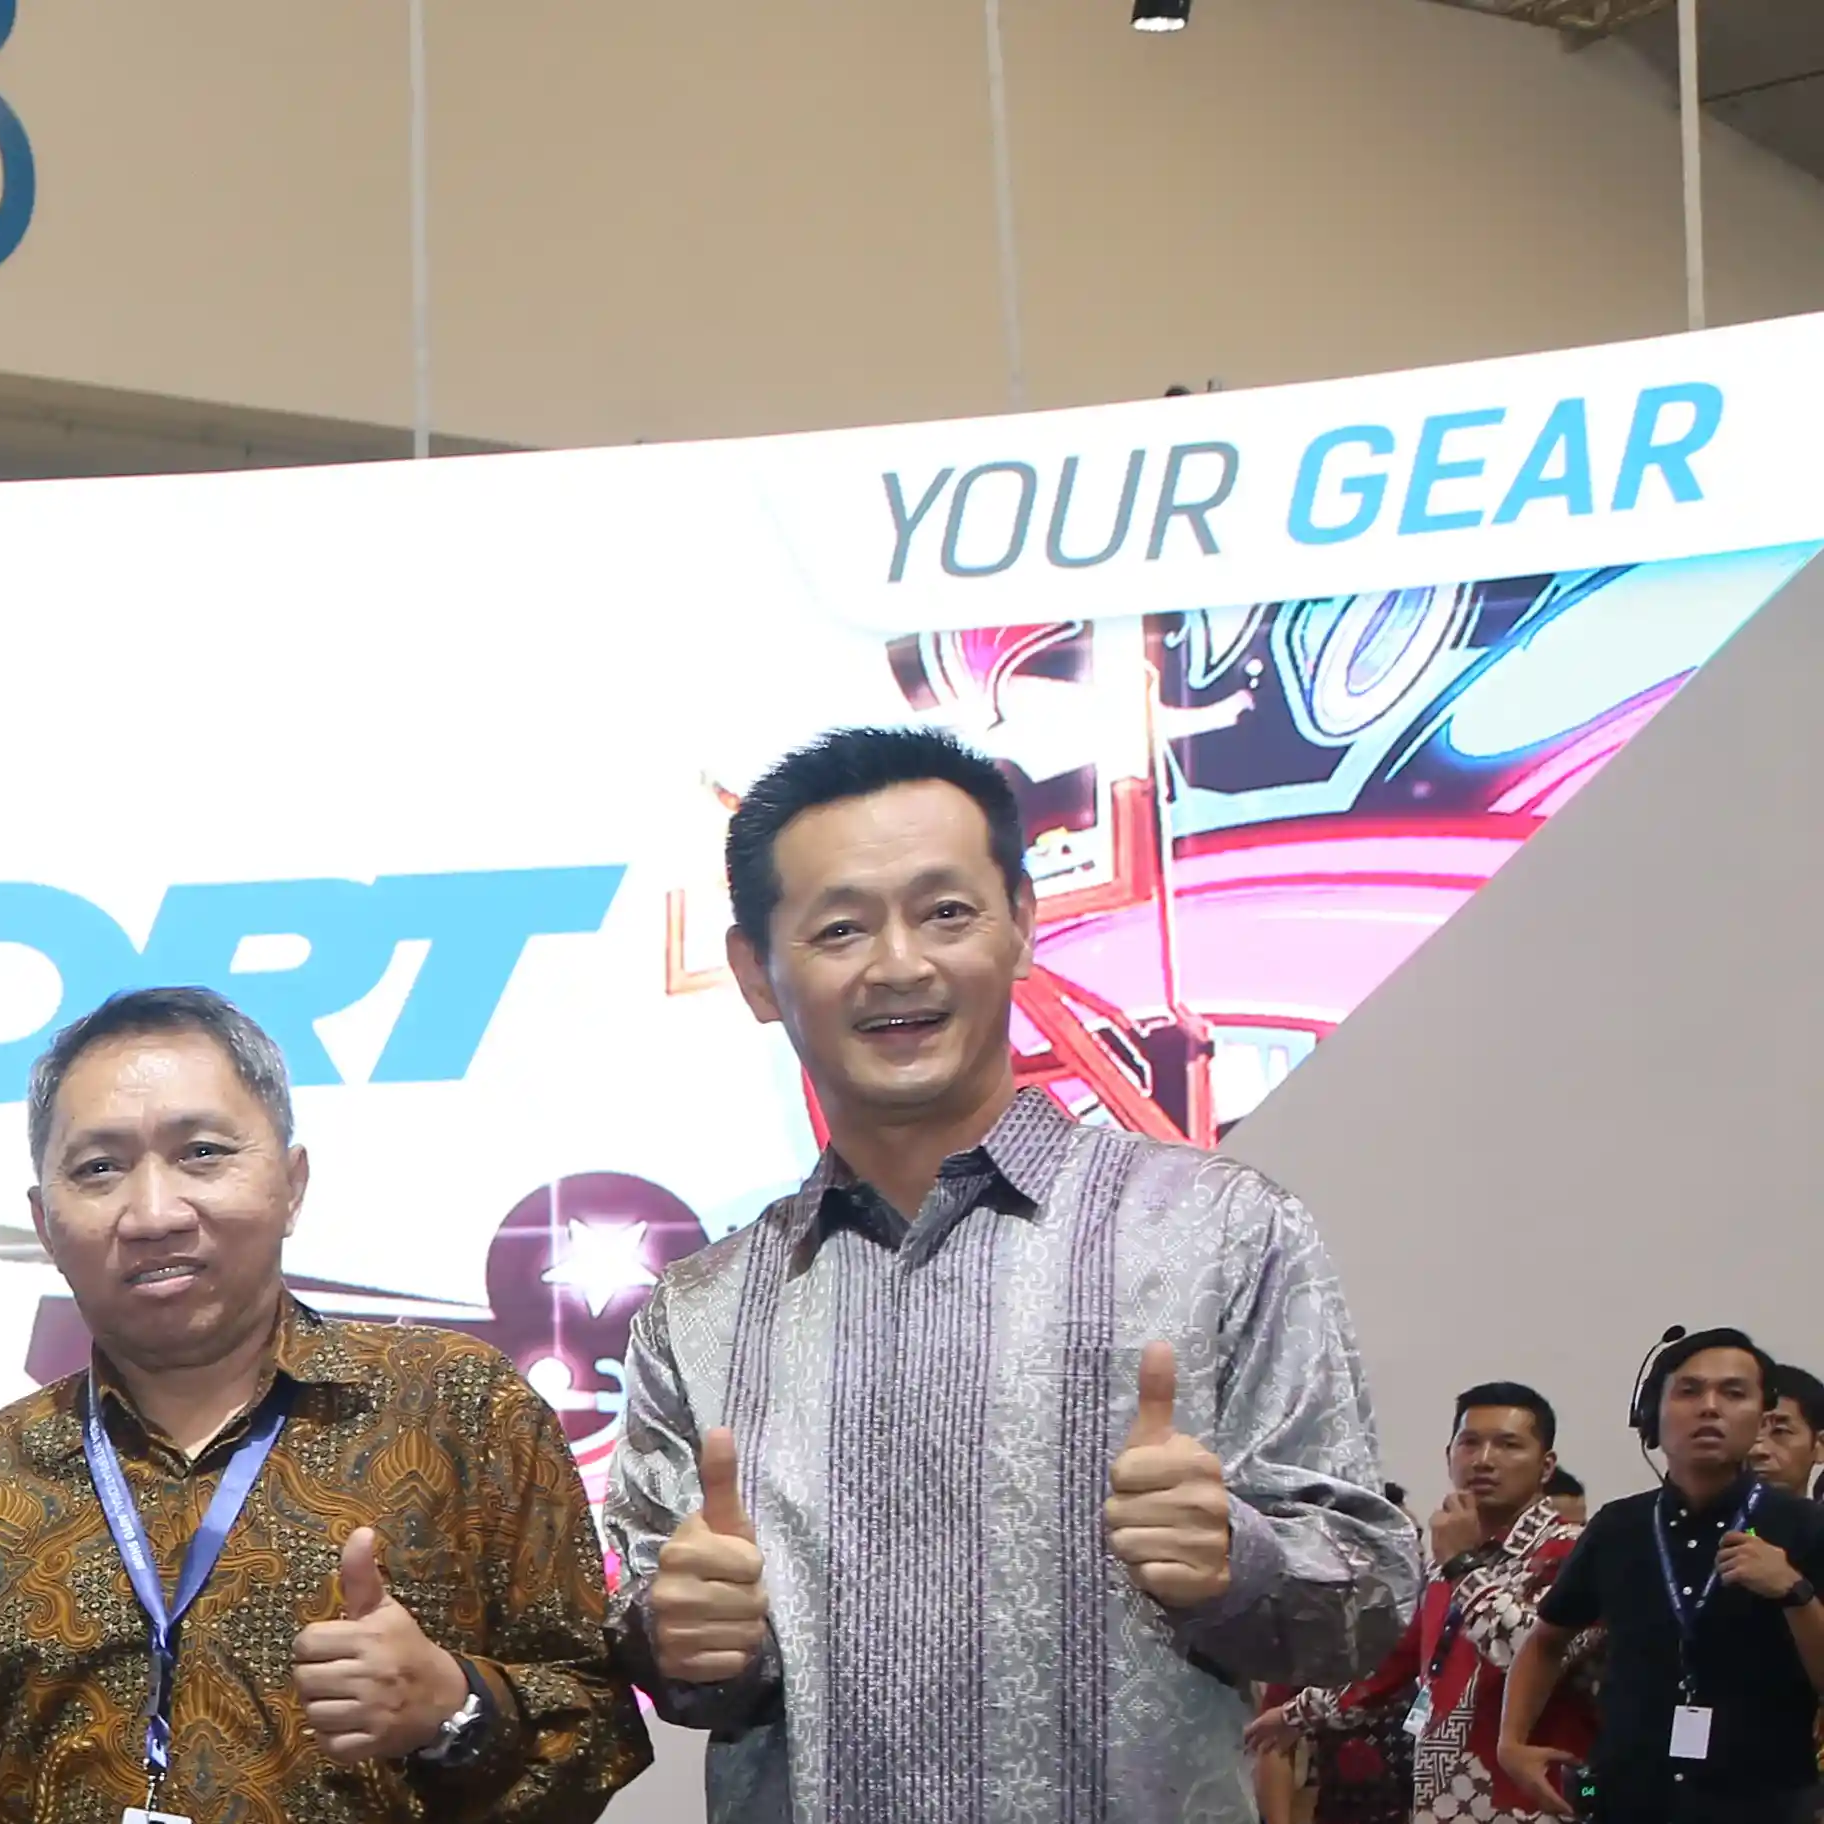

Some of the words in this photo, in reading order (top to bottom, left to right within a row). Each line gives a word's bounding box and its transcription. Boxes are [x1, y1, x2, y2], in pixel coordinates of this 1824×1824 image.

[880, 440, 1240, 584] YOUR
[1287, 380, 1725, 546] GEAR
[117, 1514, 136, 1540] AUTO
